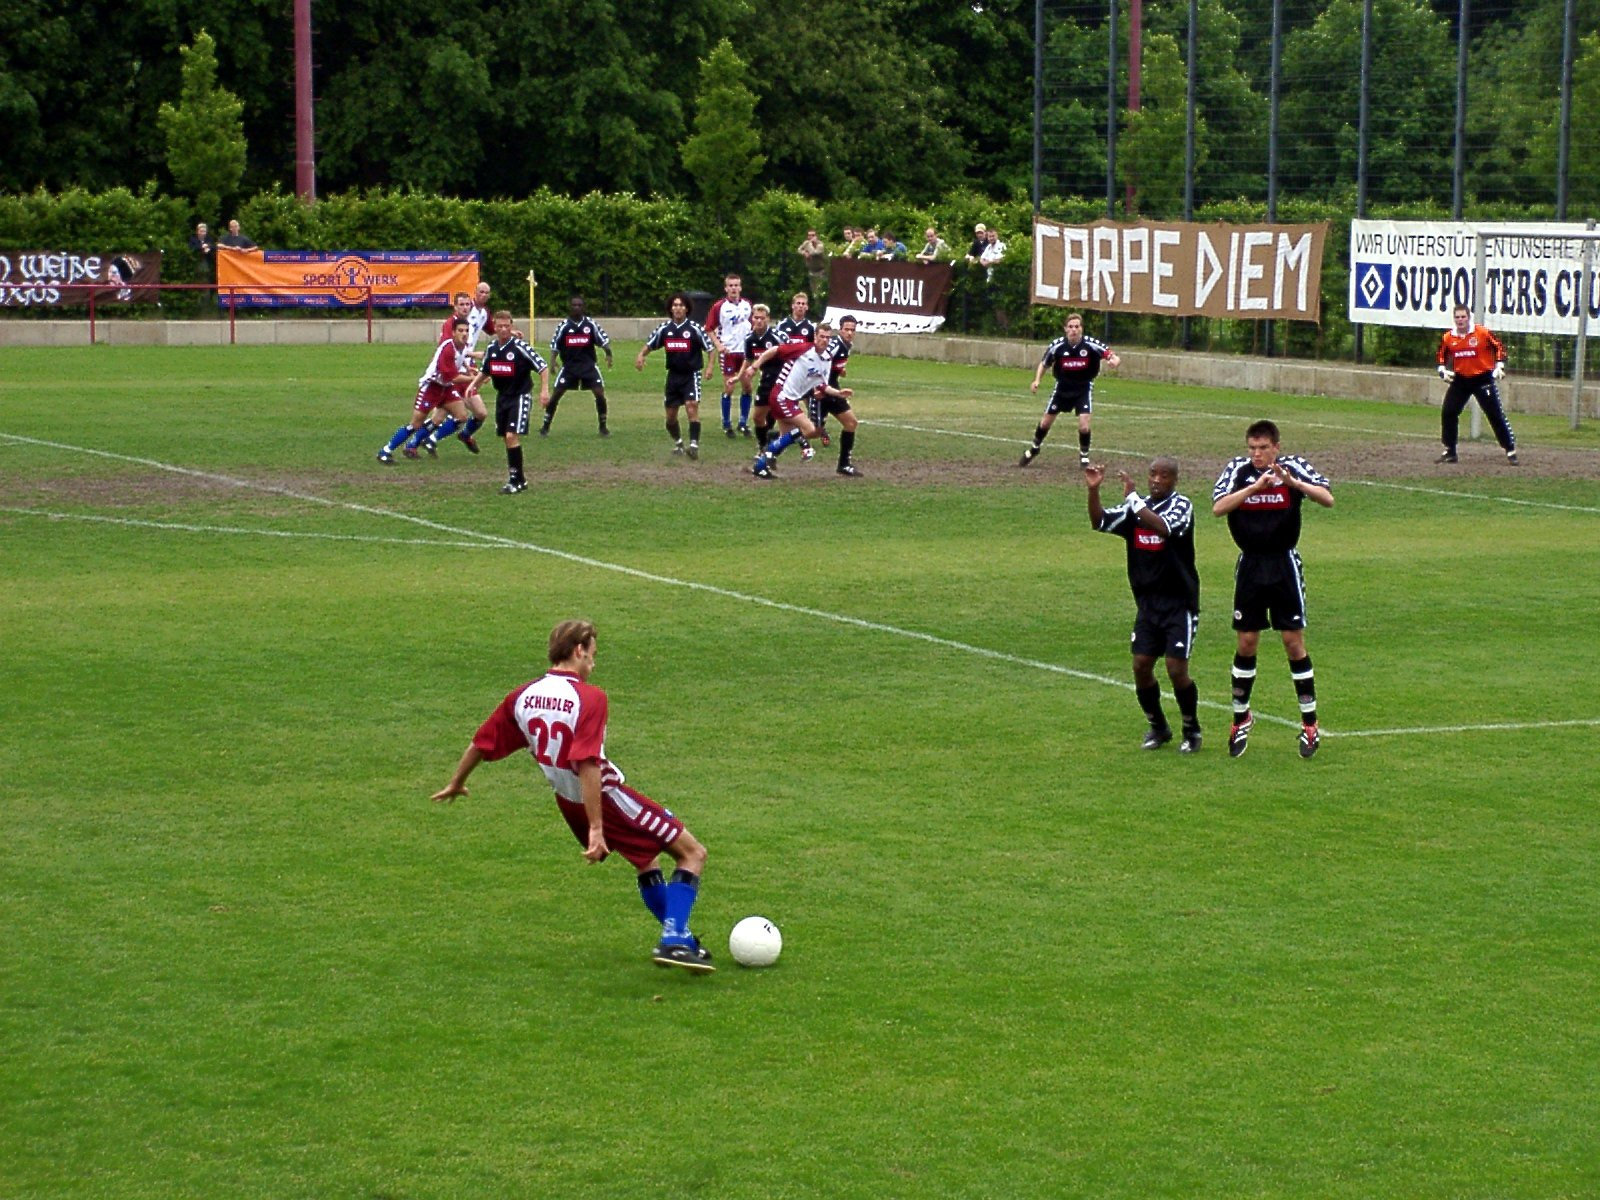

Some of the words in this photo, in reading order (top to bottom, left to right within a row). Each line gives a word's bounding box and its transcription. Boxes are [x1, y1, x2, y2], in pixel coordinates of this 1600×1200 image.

[1356, 232, 1383, 254] WIR
[1387, 230, 1504, 258] UNTERSTÜTEN
[1035, 223, 1180, 308] CARPE
[1195, 231, 1312, 311] DIEM
[856, 275, 877, 304] ST.
[881, 277, 923, 307] PAULI
[1395, 265, 1548, 317] SUPPOTERS
[1245, 493, 1284, 504] ASTRA
[524, 696, 574, 713] SCHINDLER
[528, 717, 575, 769] 22
